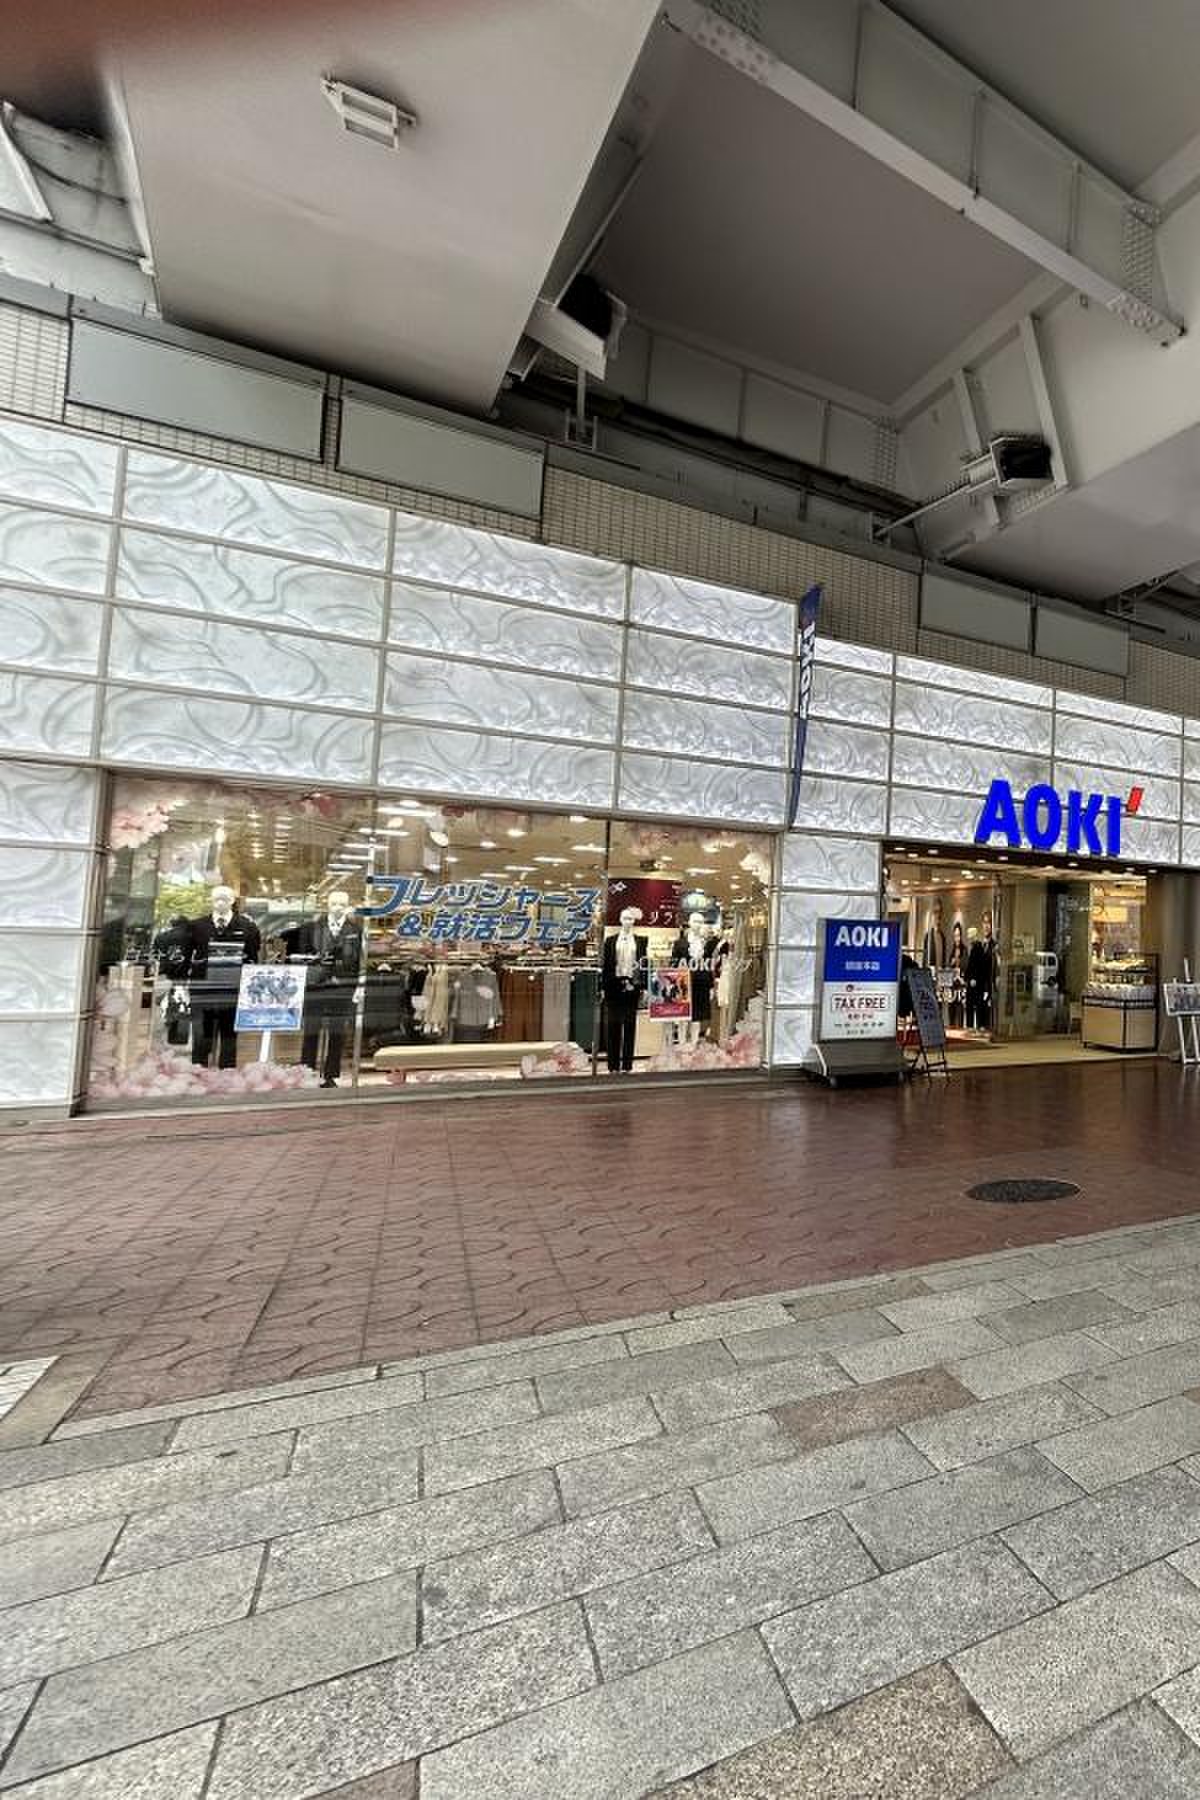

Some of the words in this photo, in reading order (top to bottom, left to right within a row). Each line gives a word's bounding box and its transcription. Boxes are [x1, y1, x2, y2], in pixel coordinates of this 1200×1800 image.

[974, 779, 1121, 858] AOKI
[834, 926, 889, 947] AOKI
[834, 997, 856, 1009] TAX
[858, 997, 886, 1009] FREE
